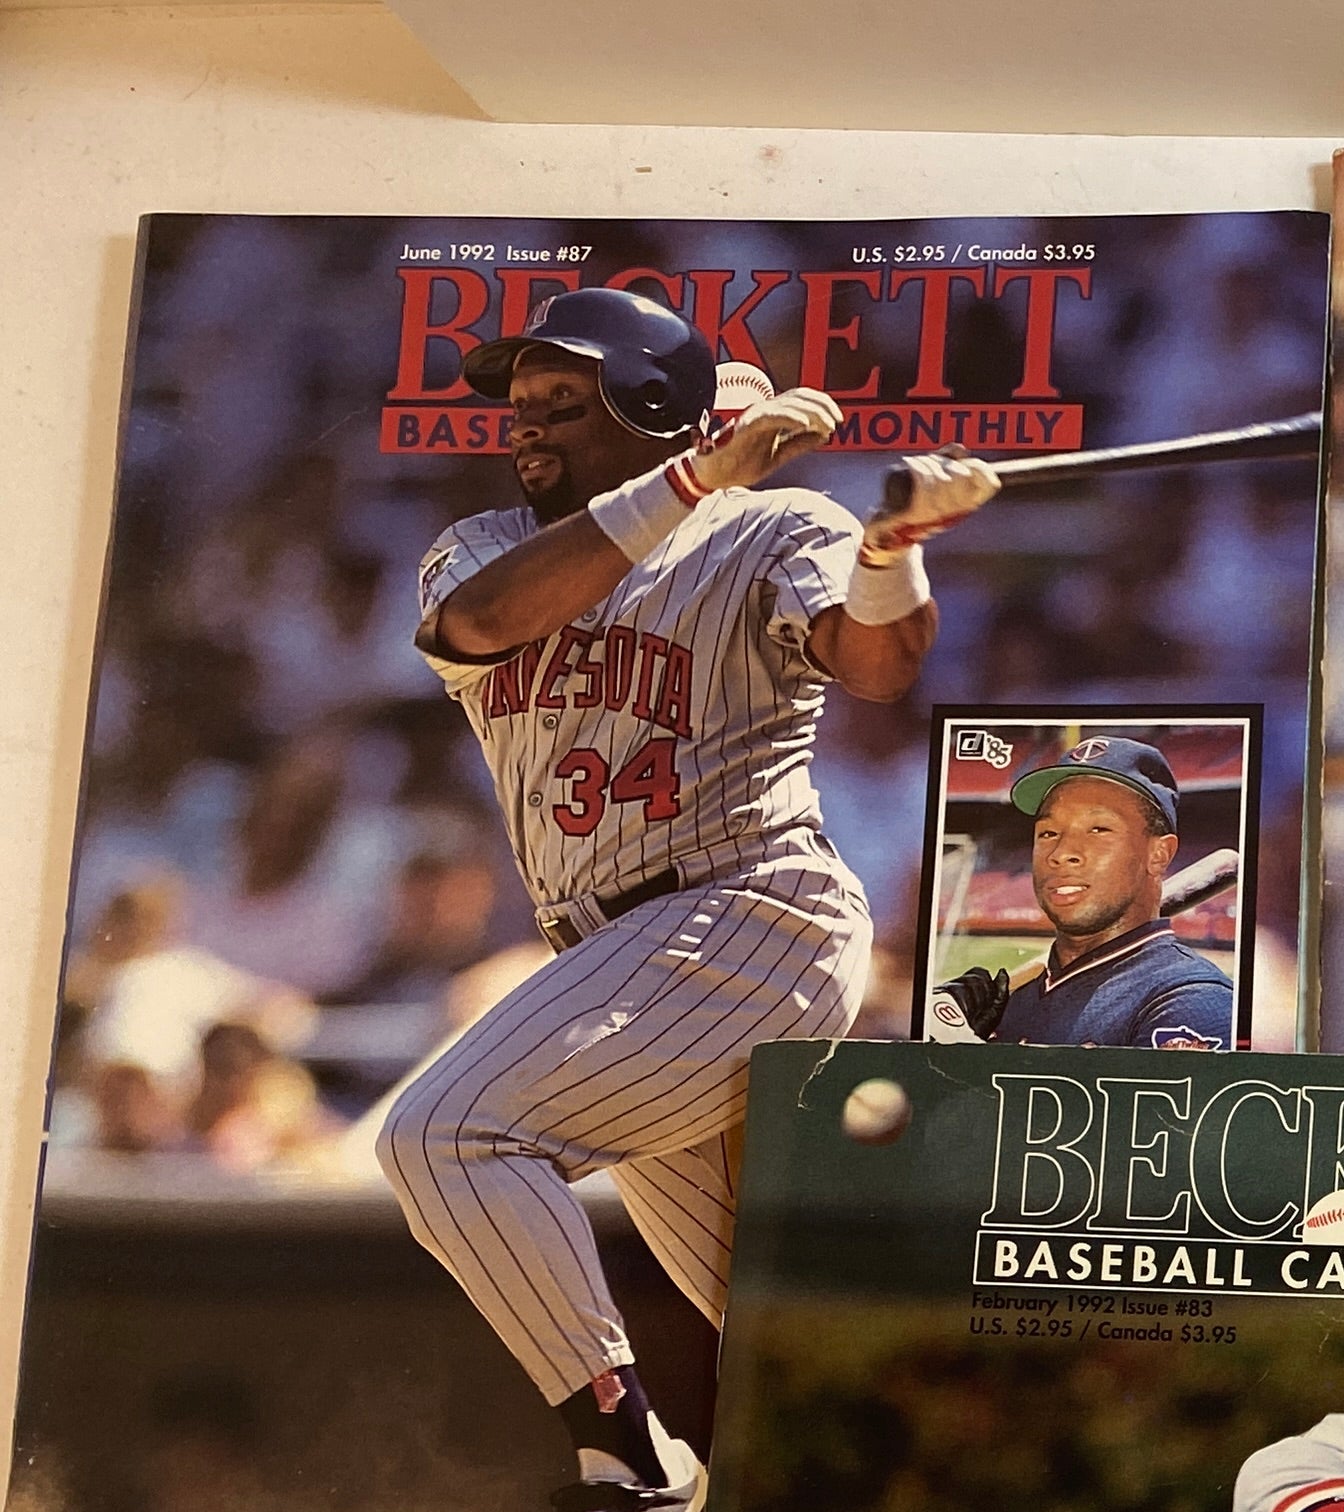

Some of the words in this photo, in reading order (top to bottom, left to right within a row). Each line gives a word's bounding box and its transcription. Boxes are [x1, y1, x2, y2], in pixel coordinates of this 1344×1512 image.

[400, 244, 441, 260] June
[450, 244, 495, 261] 1992
[507, 245, 550, 261] Issue
[556, 246, 592, 262] #87
[852, 247, 887, 263] U.S.
[894, 245, 945, 262] $2.95
[951, 243, 962, 263] /
[967, 243, 1037, 261] Canada
[1043, 243, 1096, 262] $3.95
[824, 408, 1064, 446] MONTHLY
[482, 624, 693, 741] NESOTA
[552, 737, 681, 838] 34
[994, 1239, 1252, 1289] BASEBALL
[972, 1291, 1058, 1316] February
[1067, 1295, 1115, 1314] 1992
[1122, 1297, 1168, 1316] Issue
[1175, 1299, 1213, 1318] #83
[969, 1316, 1007, 1336] U.S.
[1015, 1317, 1072, 1338] $2.95
[1079, 1319, 1091, 1341] /
[1098, 1321, 1172, 1341] Canada
[1180, 1323, 1237, 1344] $3.95
